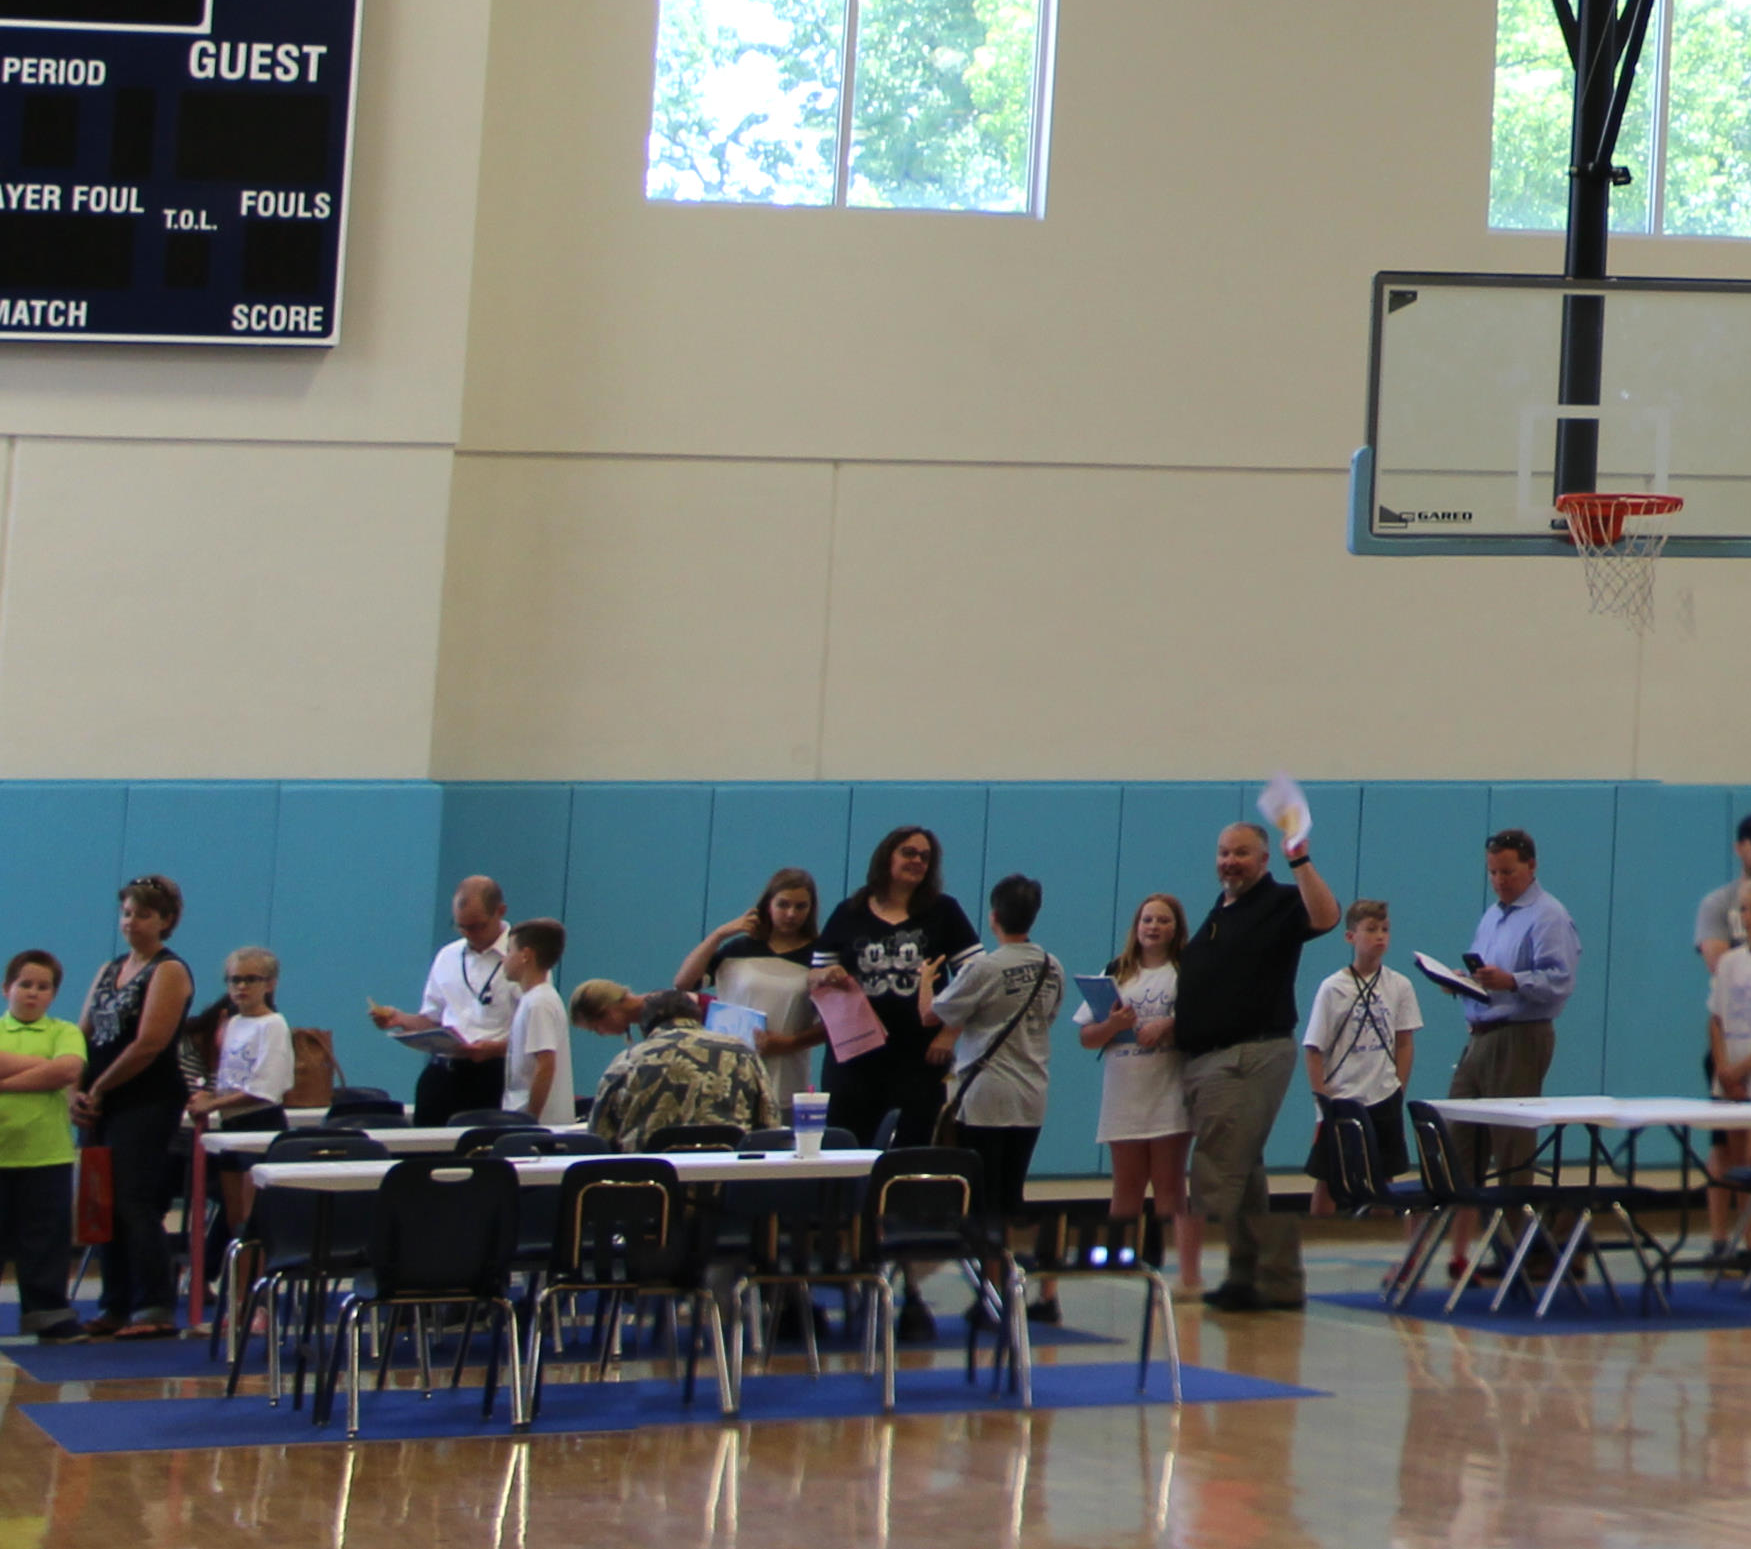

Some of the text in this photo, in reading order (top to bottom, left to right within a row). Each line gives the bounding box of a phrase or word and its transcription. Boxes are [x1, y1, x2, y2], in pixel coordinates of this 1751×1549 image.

[2, 57, 106, 86] PERIOD
[188, 40, 328, 83] GUEST
[72, 186, 145, 214] FOUL
[240, 190, 331, 219] FOULS
[163, 209, 218, 231] T.O.L.
[231, 304, 324, 332] SCORE
